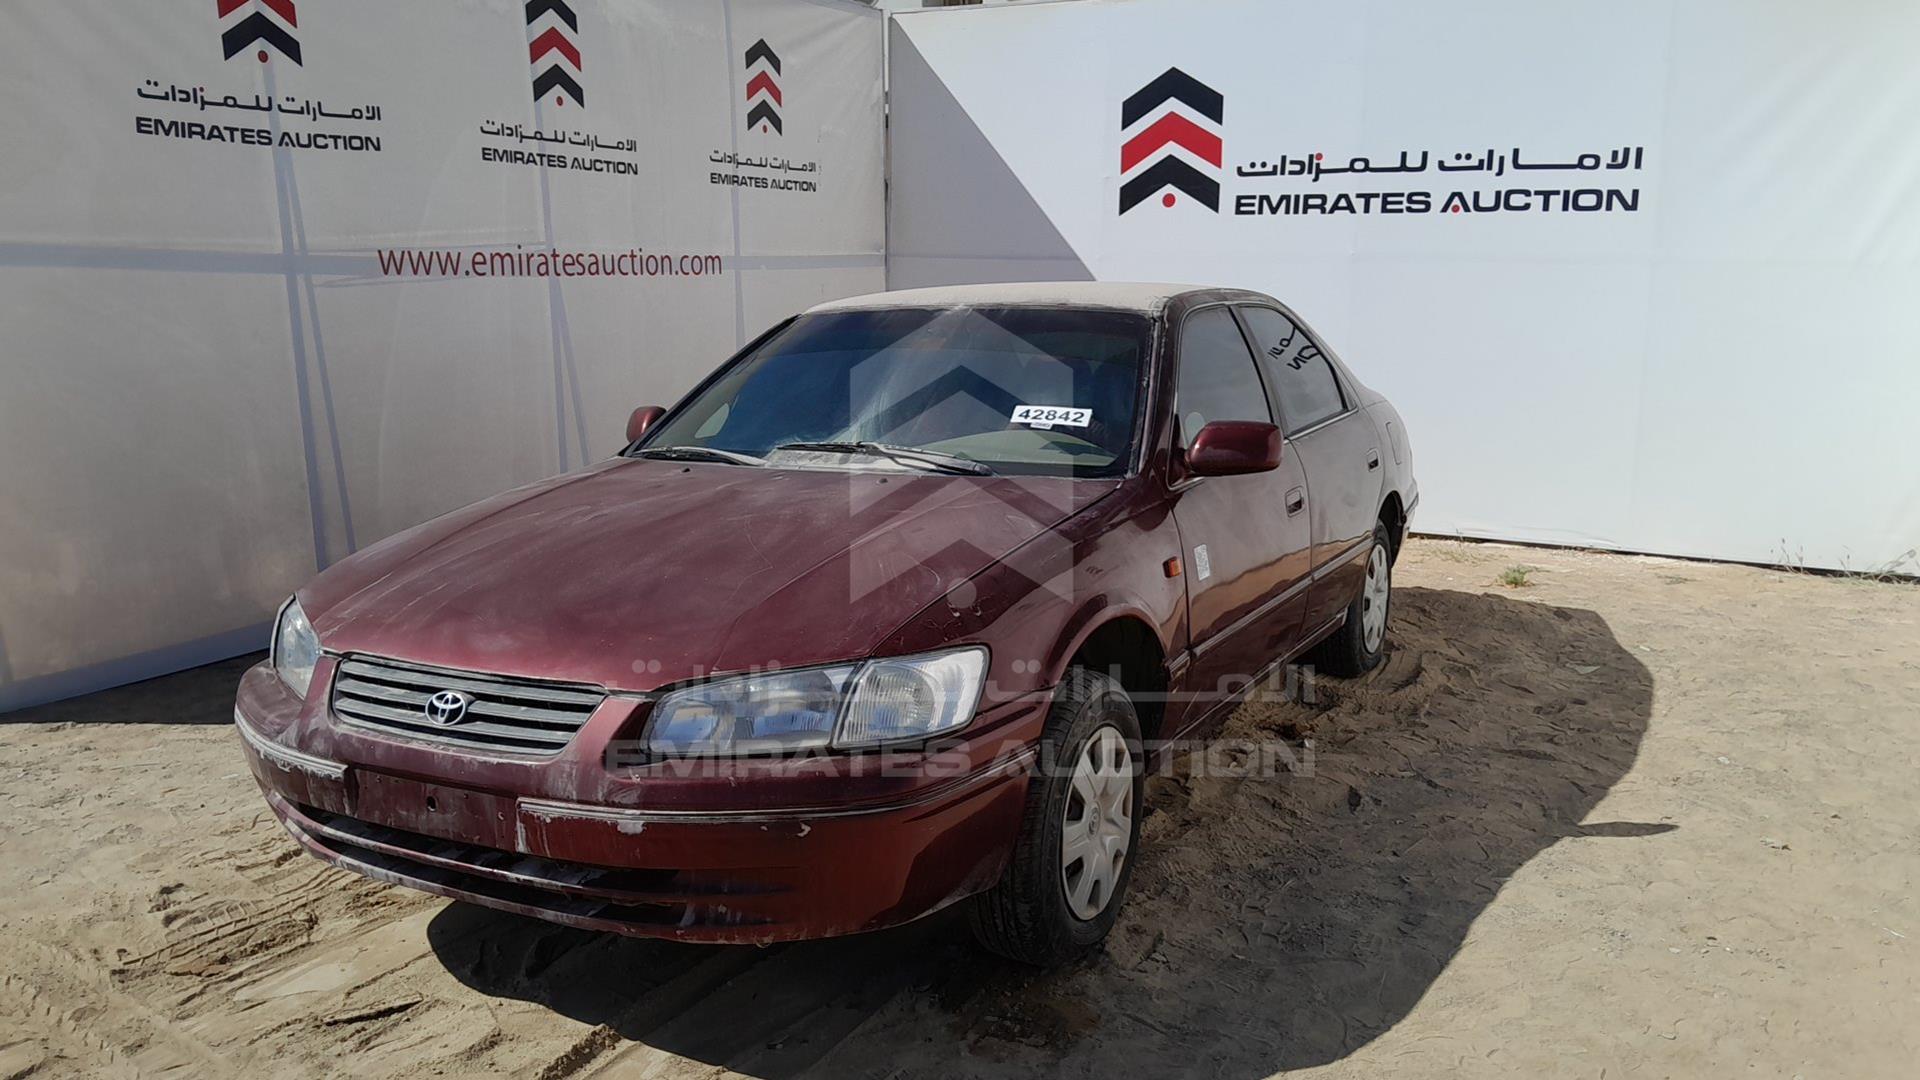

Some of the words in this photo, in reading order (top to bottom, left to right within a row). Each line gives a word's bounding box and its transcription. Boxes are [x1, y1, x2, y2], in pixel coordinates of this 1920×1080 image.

[136, 79, 273, 111] للمزادات
[277, 96, 382, 122] الامارات
[135, 116, 273, 146] EMIRATES
[278, 131, 381, 151] AUCTION
[481, 147, 567, 168] EMIRATES
[571, 157, 638, 175] AUCTION
[1236, 151, 1428, 182] للمزادات
[1438, 147, 1643, 176] الامارات
[710, 172, 769, 189] EMIRATES
[770, 179, 816, 192] AUCTION
[1234, 191, 1431, 215] EMIRATES
[1440, 189, 1640, 214] AUCTION
[377, 244, 723, 277] www.emiratesauction.com
[1018, 408, 1085, 423] 42842
